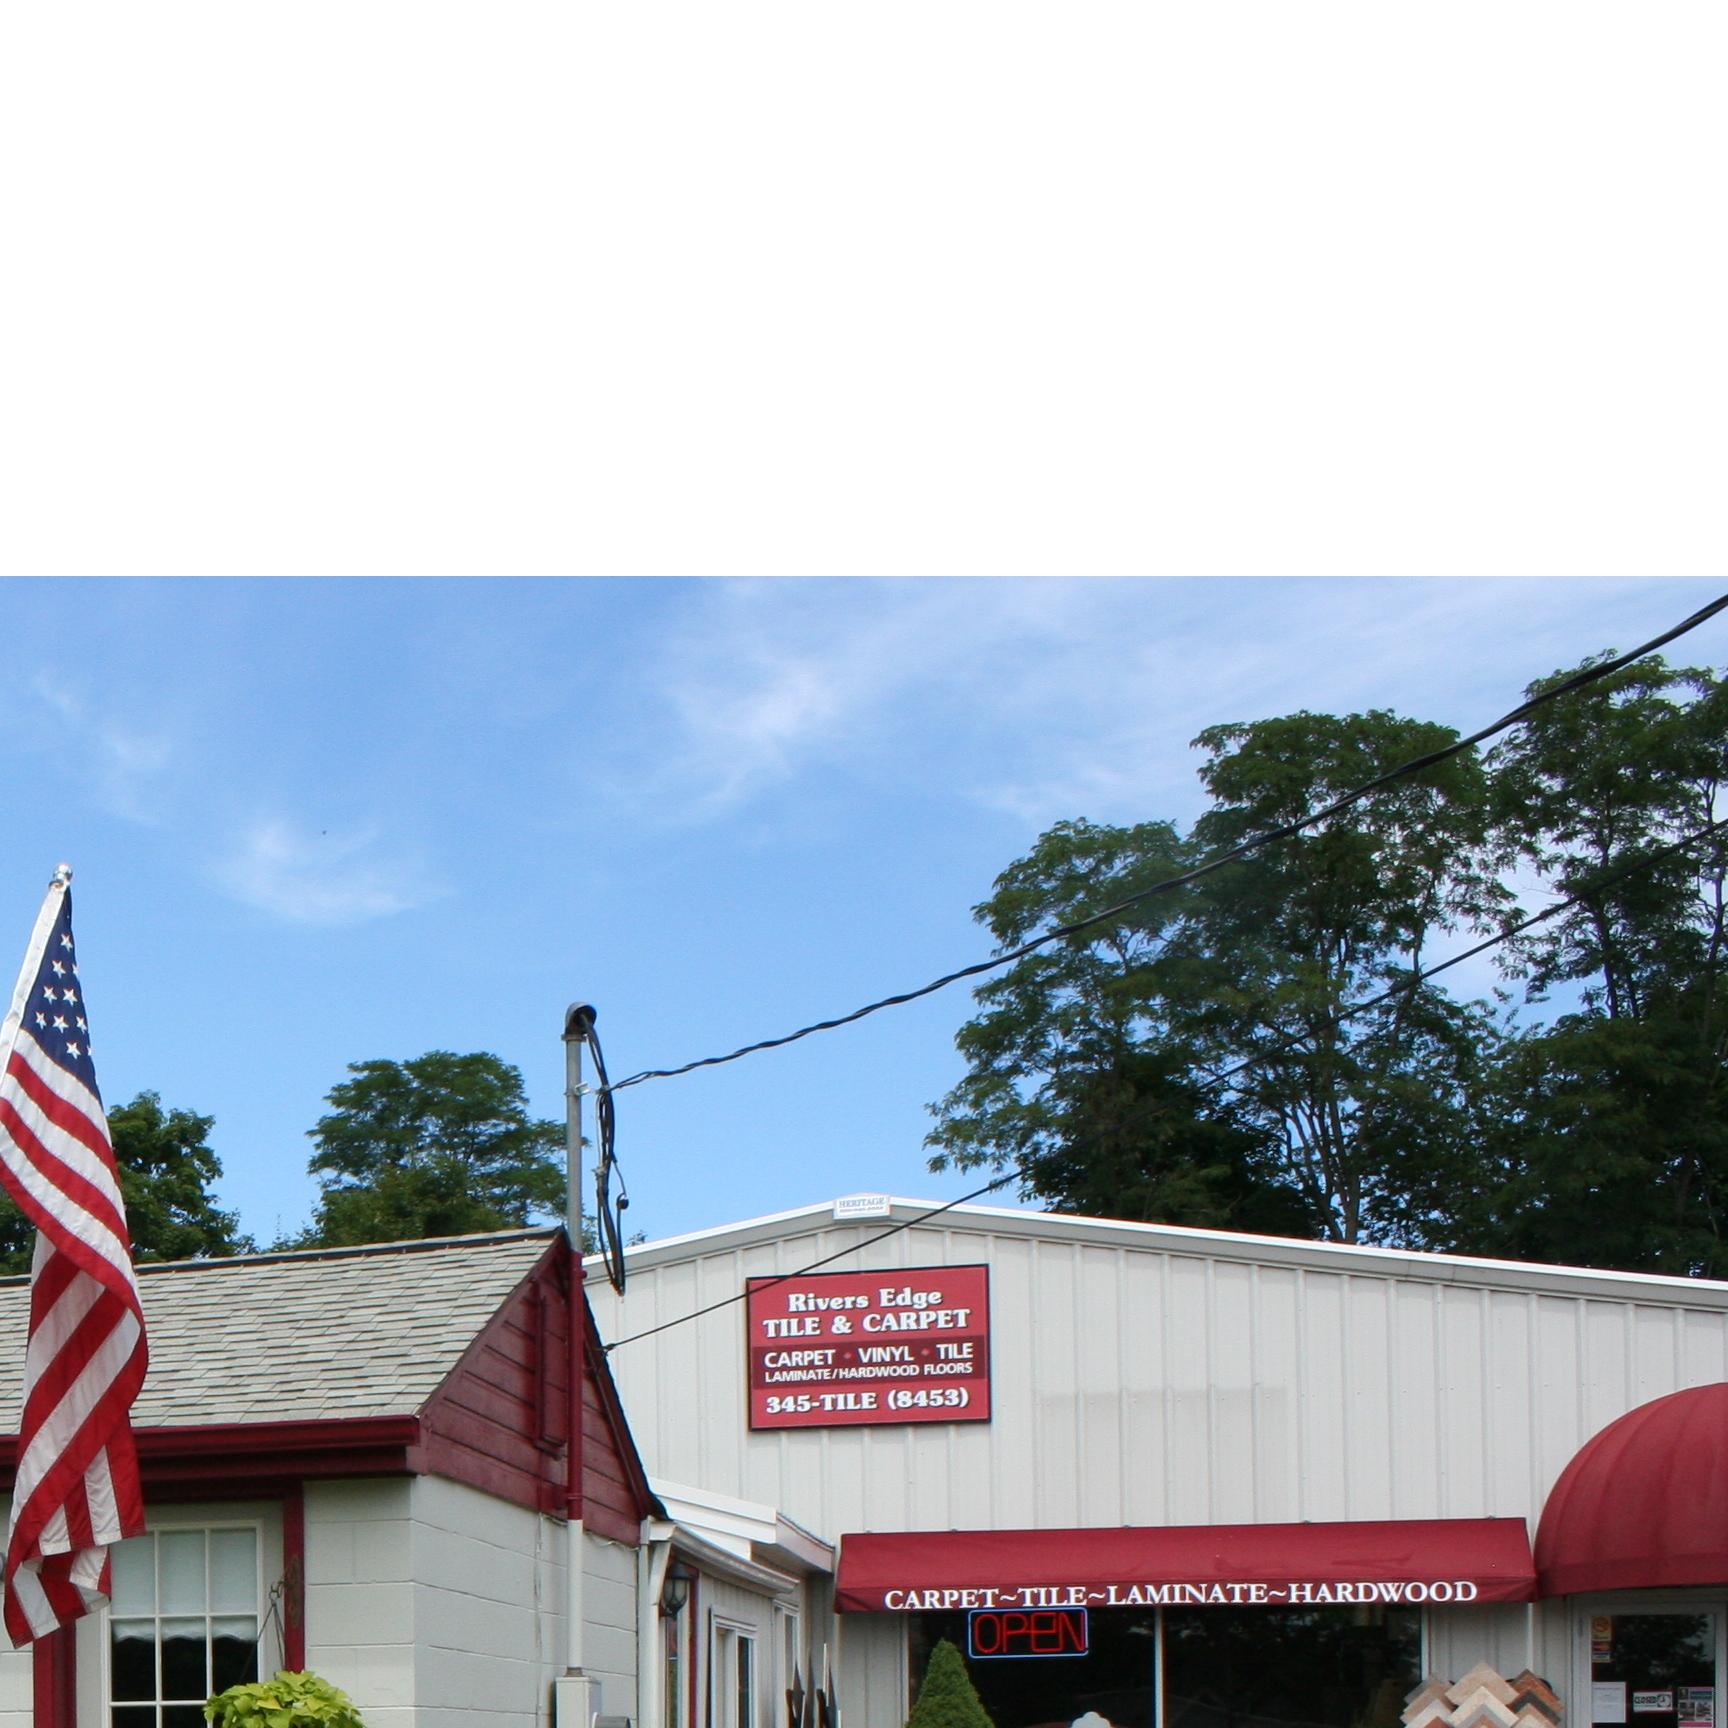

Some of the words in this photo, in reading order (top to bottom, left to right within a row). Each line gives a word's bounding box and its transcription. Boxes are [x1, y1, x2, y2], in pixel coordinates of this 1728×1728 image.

[788, 1293, 869, 1312] Rivers
[879, 1287, 942, 1310] Edge
[763, 1316, 821, 1338] TILE
[831, 1315, 852, 1334] &
[863, 1309, 970, 1332] CARPET
[764, 1349, 836, 1368] CARPET
[858, 1345, 914, 1363] VINYL
[936, 1342, 973, 1359] TILE
[923, 1362, 973, 1376] FLOORS
[766, 1392, 878, 1413] 345-TILE
[887, 1387, 969, 1410] (8453)
[974, 1611, 1086, 1653] OPEN
